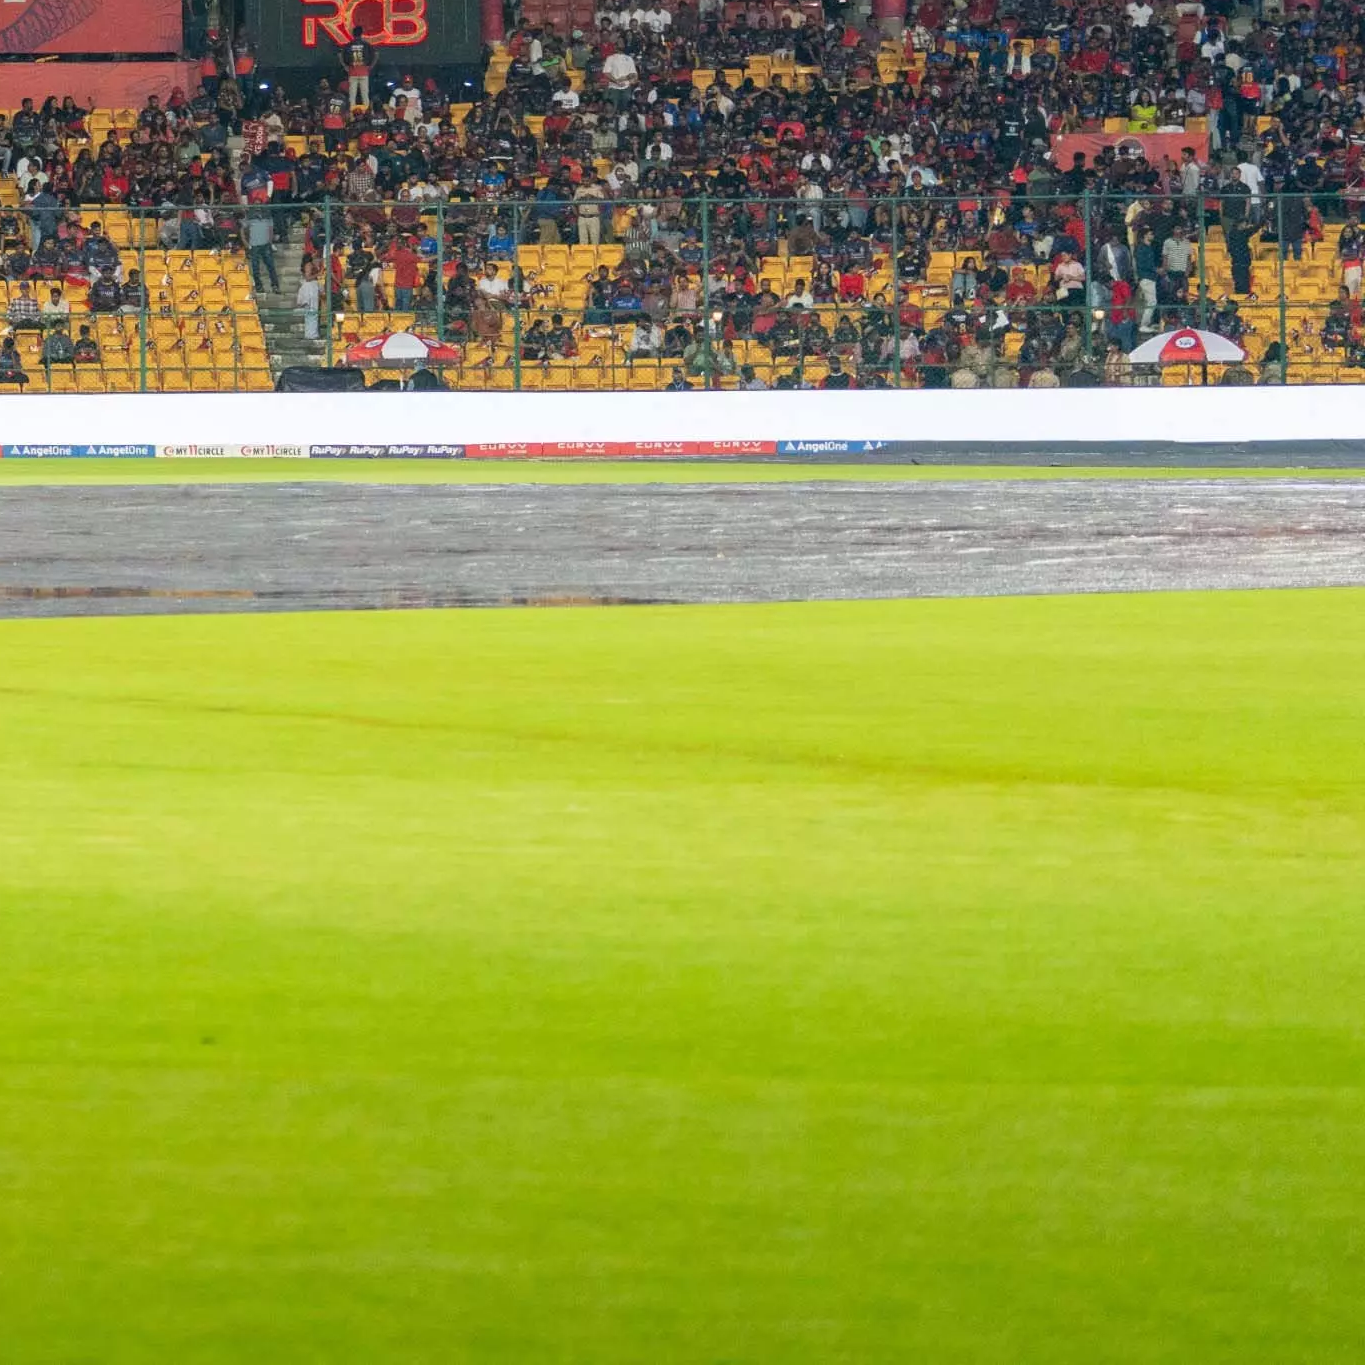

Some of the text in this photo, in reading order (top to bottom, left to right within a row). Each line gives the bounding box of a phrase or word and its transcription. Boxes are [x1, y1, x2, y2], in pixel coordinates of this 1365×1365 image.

[22, 445, 72, 456] AngelOne
[99, 445, 148, 456] AngelOne
[311, 446, 343, 456] RuPay
[350, 446, 381, 456] RuPay
[388, 446, 420, 456] RuPay
[427, 445, 459, 456] RuPay
[798, 441, 849, 452] AngelOne
